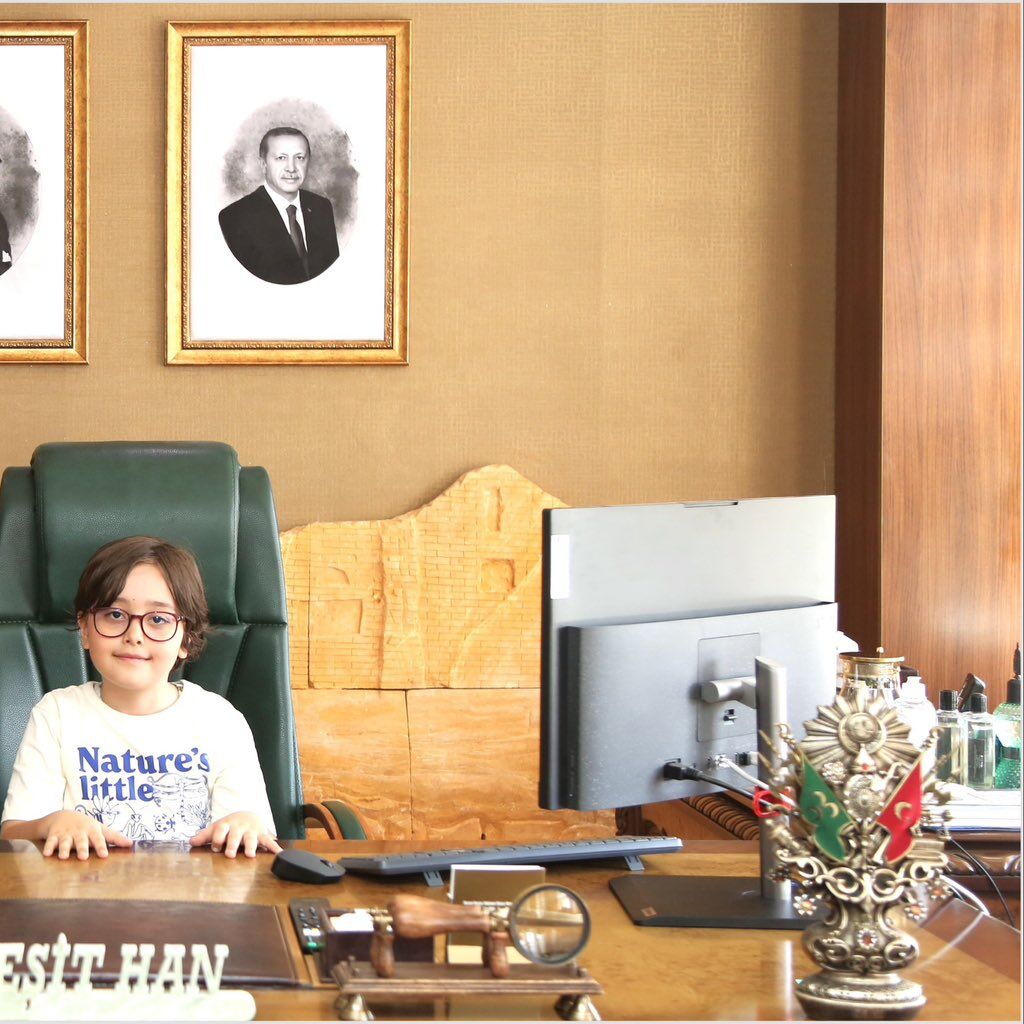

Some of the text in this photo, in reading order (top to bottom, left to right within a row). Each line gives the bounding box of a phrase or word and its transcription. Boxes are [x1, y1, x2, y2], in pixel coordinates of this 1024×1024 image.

[78, 747, 210, 774] Nature's
[80, 775, 155, 802] little
[115, 943, 229, 994] HAN
